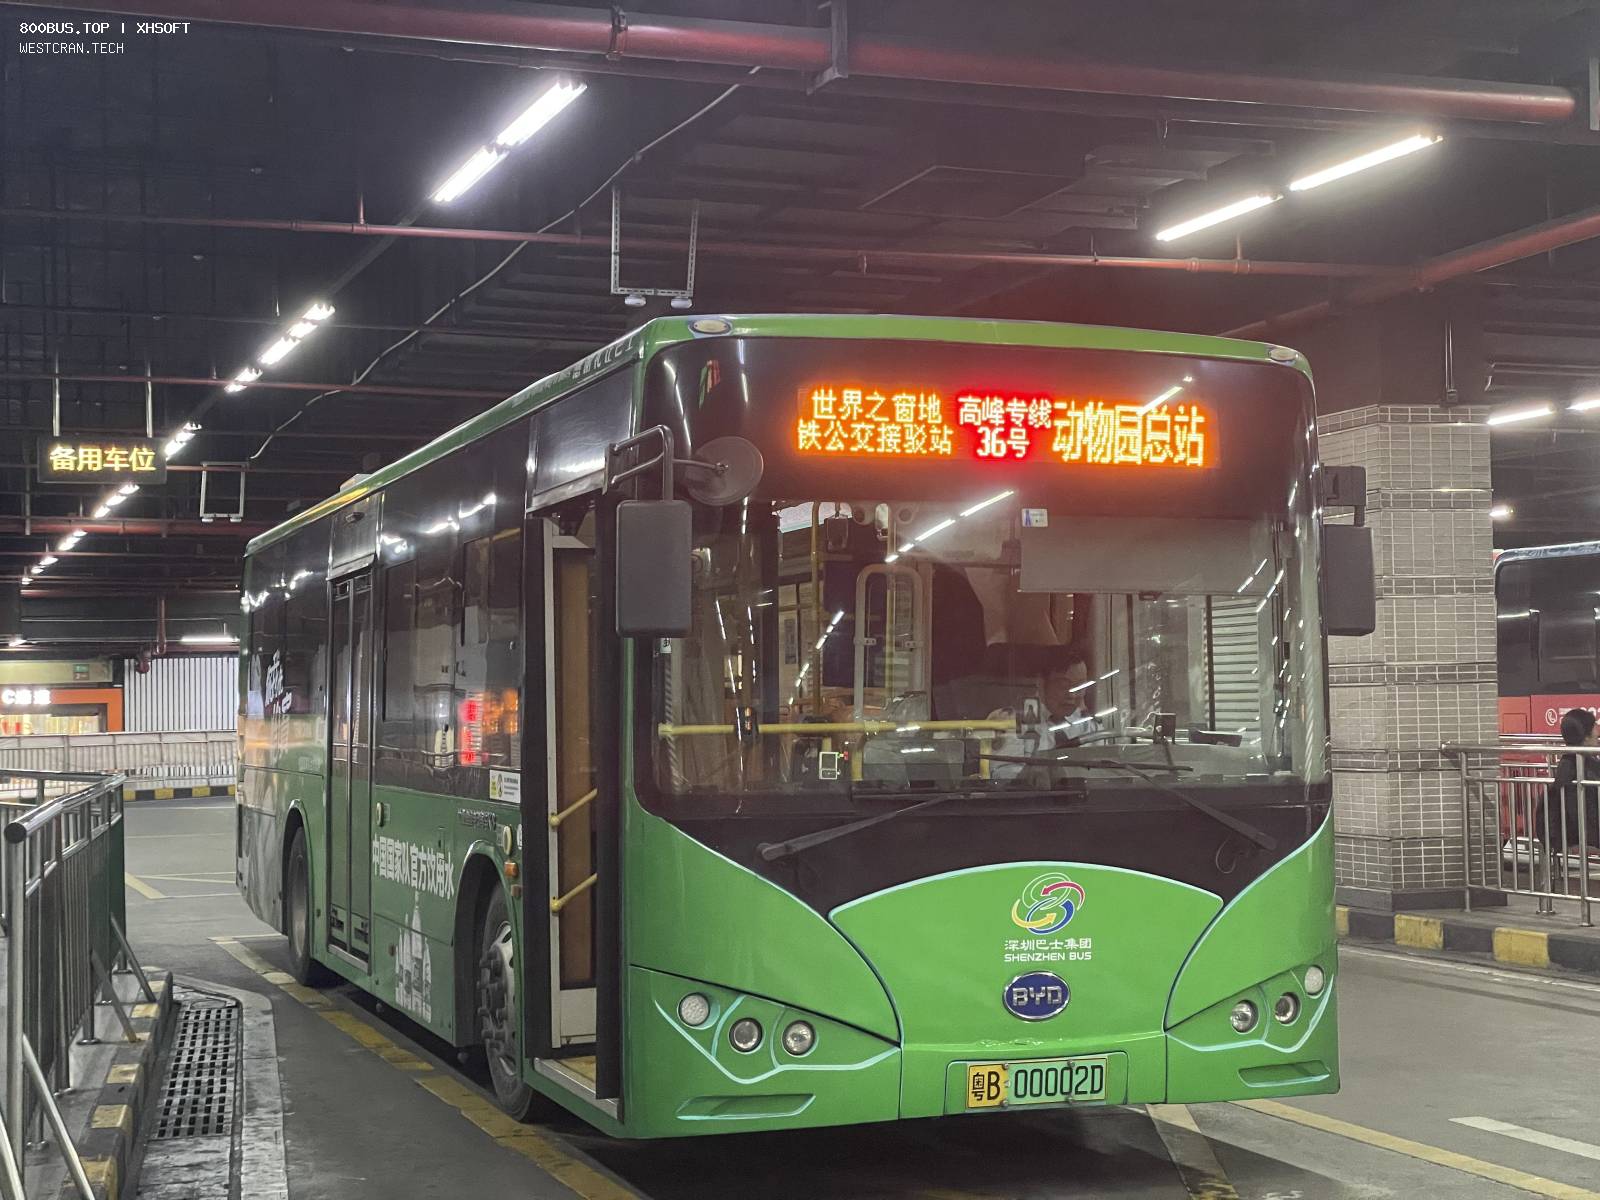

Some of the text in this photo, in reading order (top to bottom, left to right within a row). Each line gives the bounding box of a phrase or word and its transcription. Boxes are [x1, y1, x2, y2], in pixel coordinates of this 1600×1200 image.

[811, 388, 942, 422] 世界之窗地
[957, 395, 1052, 430] 高峰专线
[797, 420, 953, 456] 铁公交接驳站
[976, 427, 1030, 458] 36号
[1051, 398, 1206, 467] 动物园总站
[49, 444, 156, 472] 备用车位
[1004, 938, 1092, 951] 深圳巴士集团
[1004, 951, 1092, 962] SHENZHEN BUS
[1012, 985, 1063, 1007] BYD
